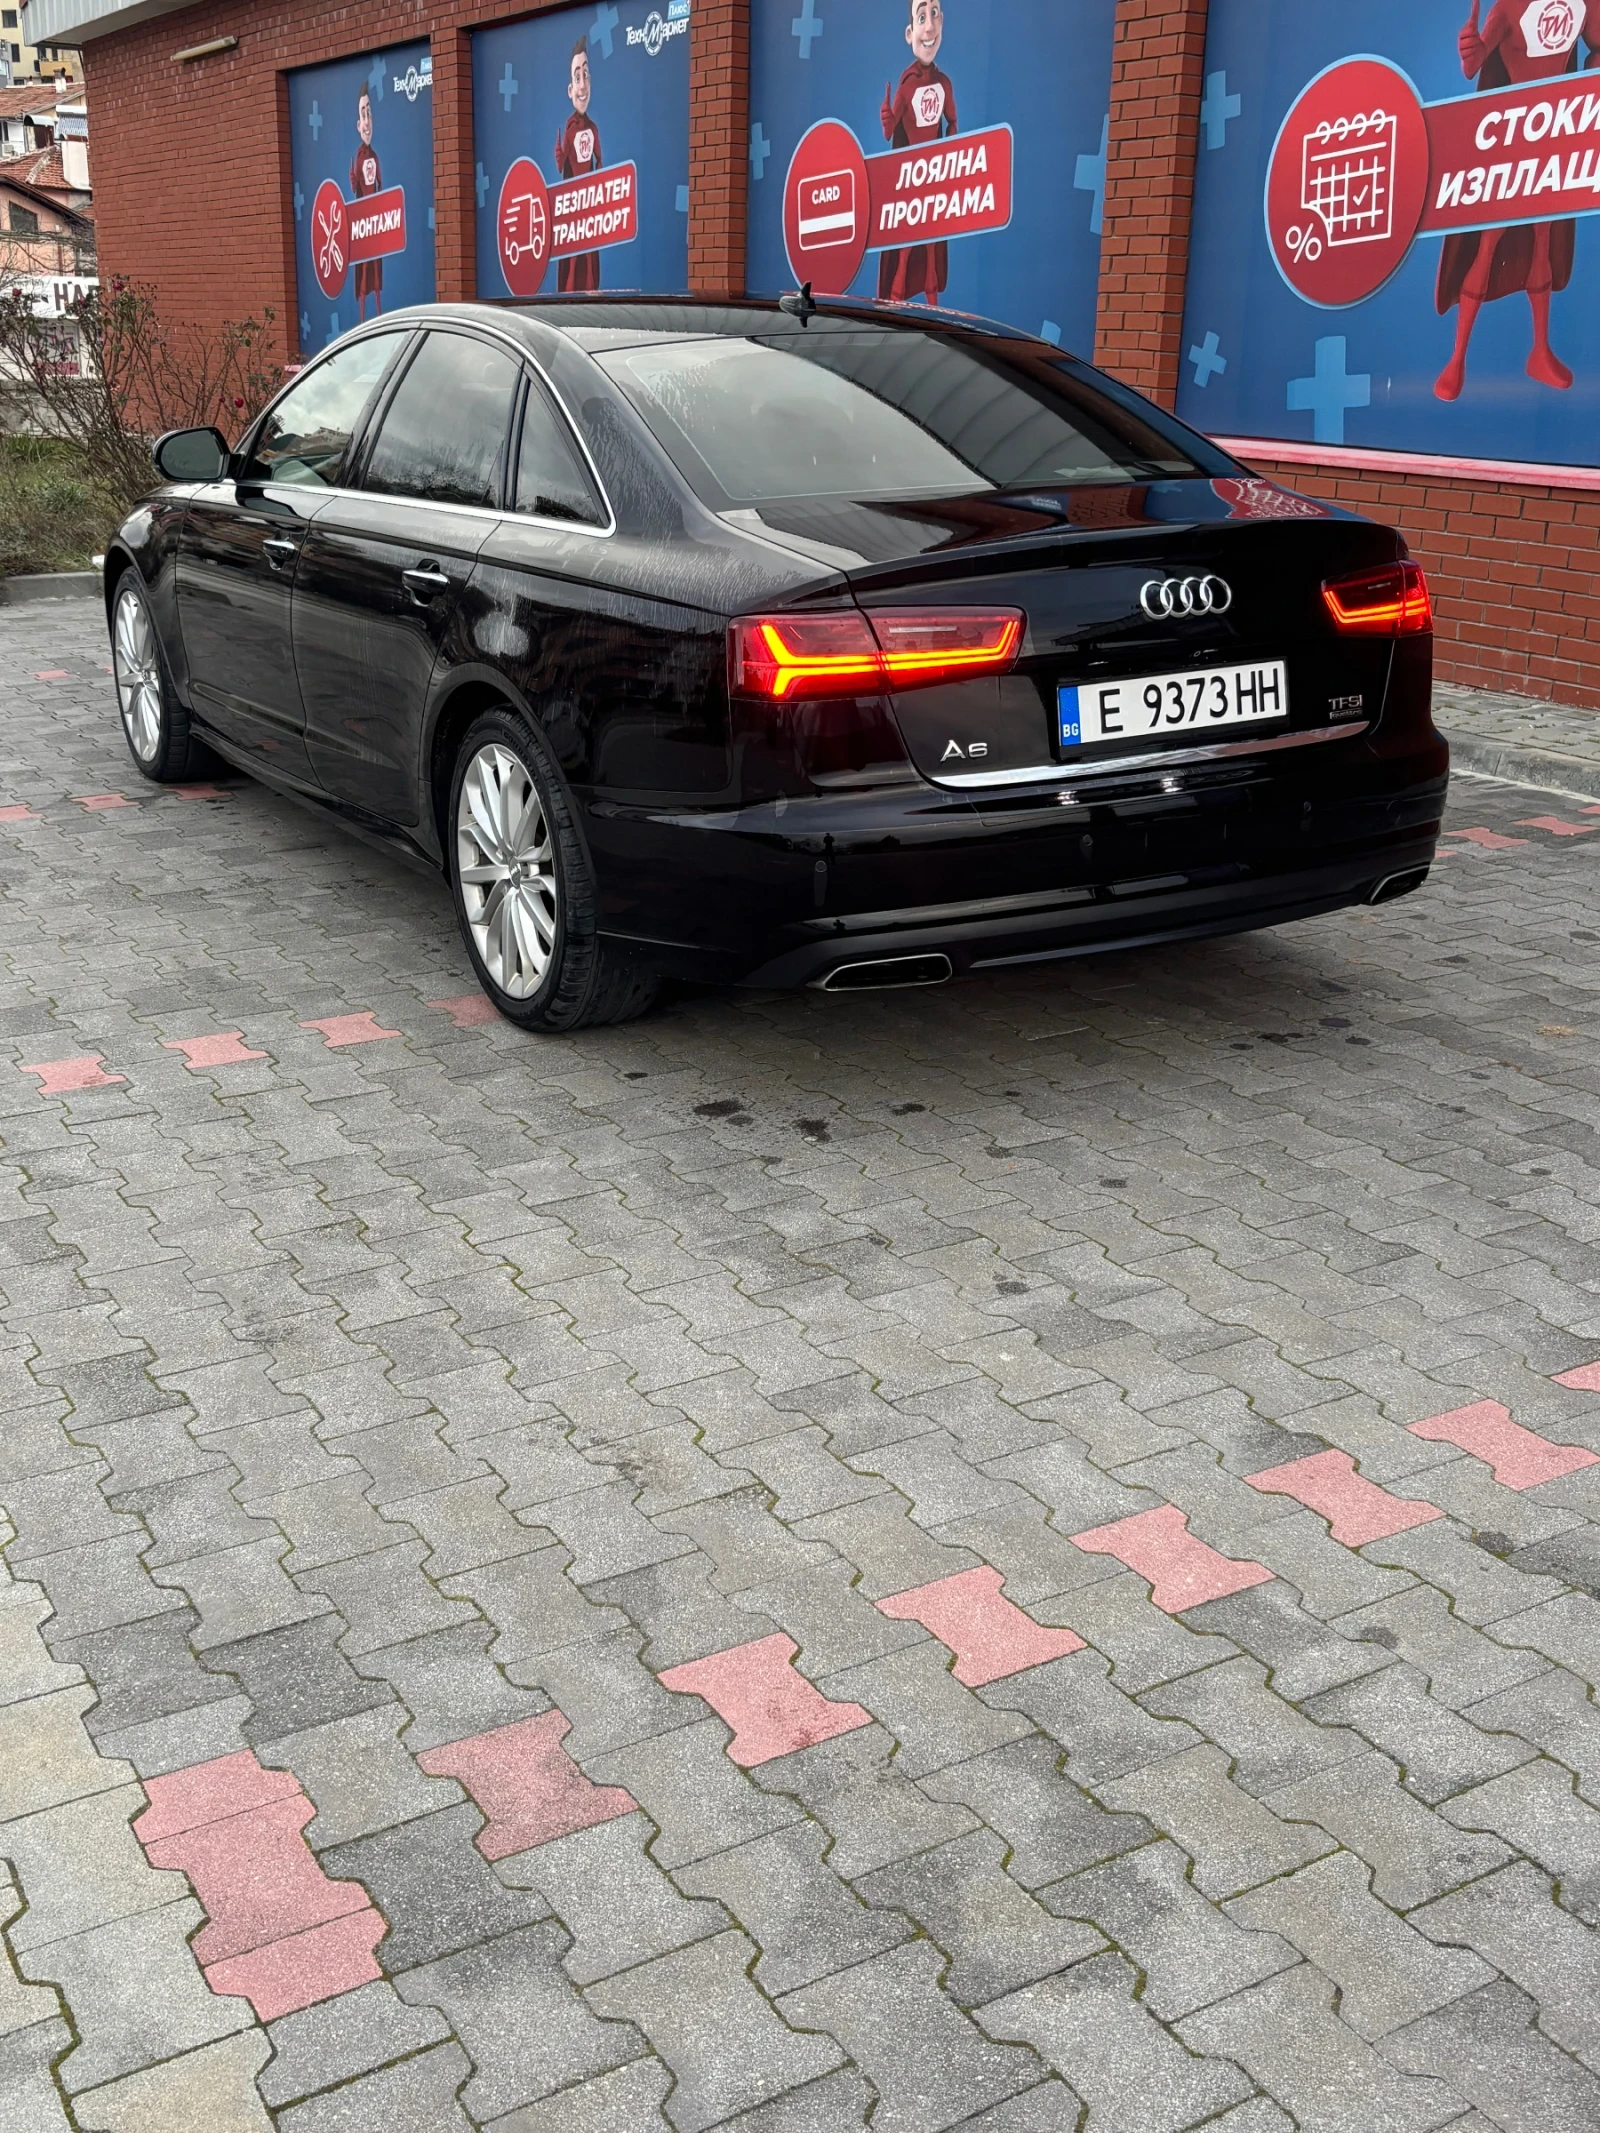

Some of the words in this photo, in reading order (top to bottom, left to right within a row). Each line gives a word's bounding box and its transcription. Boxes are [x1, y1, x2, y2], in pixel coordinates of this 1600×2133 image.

[1475, 93, 1600, 150] СТОКИ
[895, 145, 987, 190] ЛОЯЛНА
[554, 175, 631, 216] БЕЗПЛАТЕН
[812, 186, 840, 204] CARD
[879, 184, 995, 230] ПРОГРАМА
[351, 208, 401, 241] МОНТАЖИ
[553, 207, 630, 246] ТРАНСПОРТ
[1100, 689, 1123, 734] E
[1328, 694, 1363, 710] TFSI
[941, 739, 989, 762] A6
[1062, 724, 1079, 738] BG
